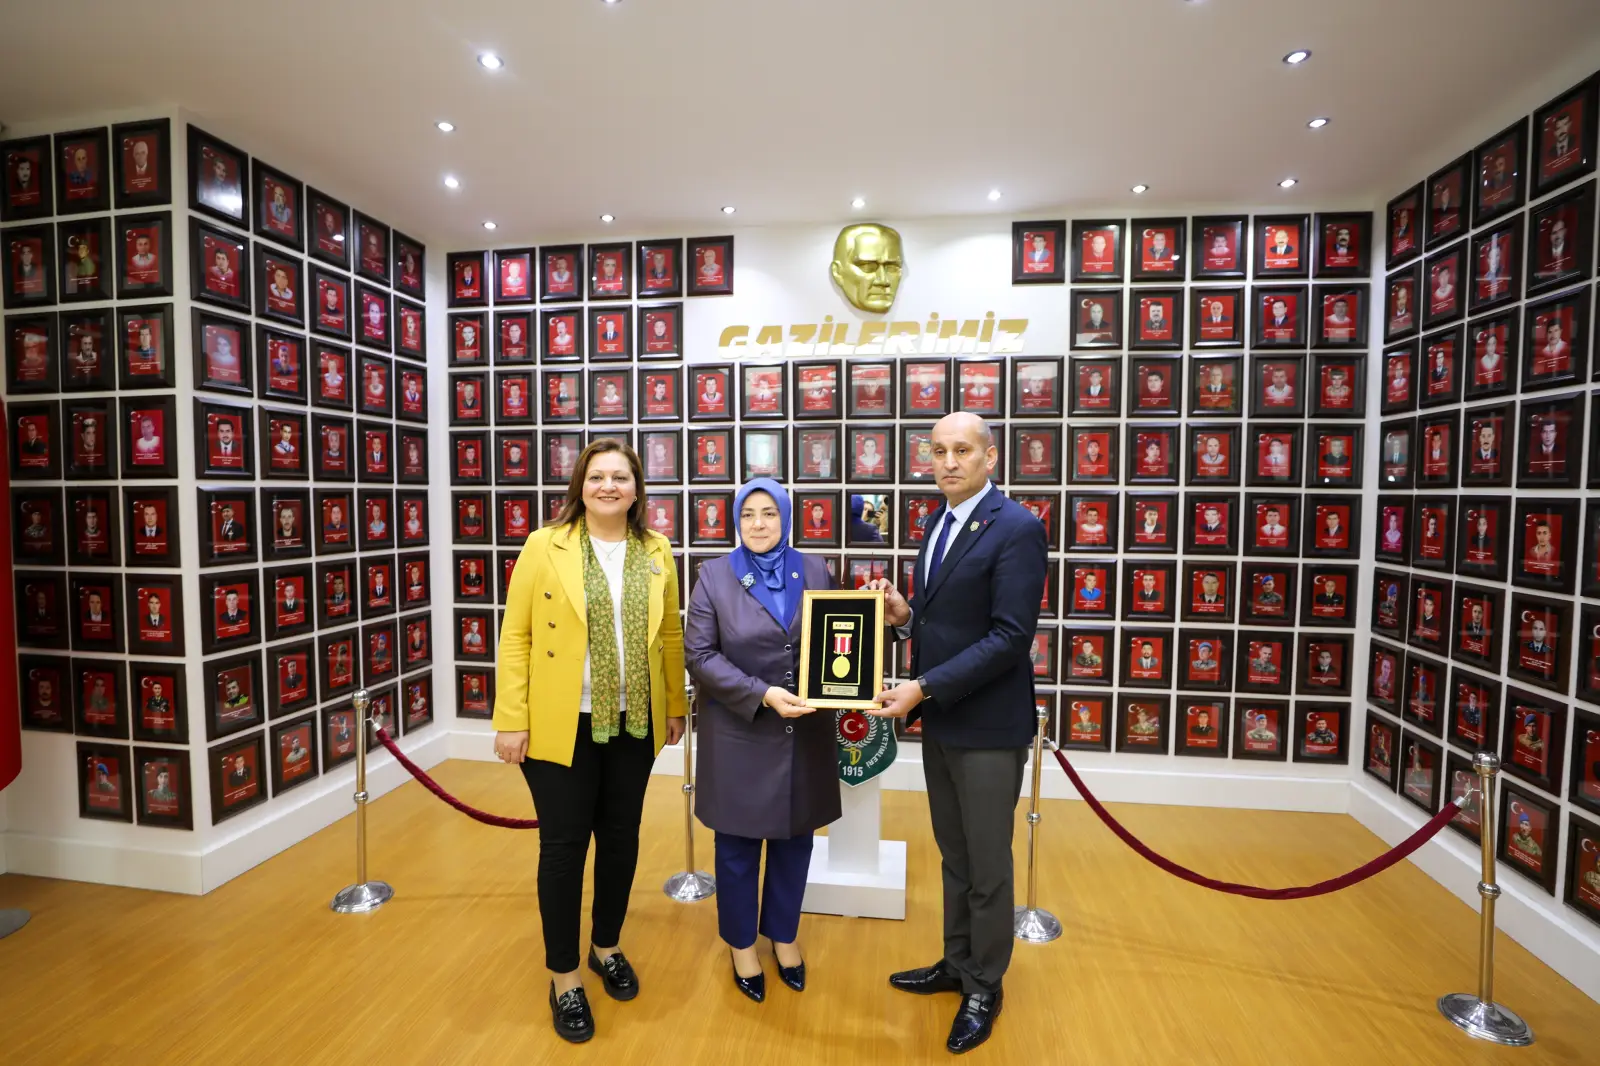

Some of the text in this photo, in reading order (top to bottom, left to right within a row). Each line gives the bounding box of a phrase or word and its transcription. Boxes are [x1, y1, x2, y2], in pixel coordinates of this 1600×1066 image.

[718, 310, 1029, 358] GAZİLERİMİZ
[866, 732, 889, 768] YETİMLERİ
[842, 765, 864, 777] 1915
